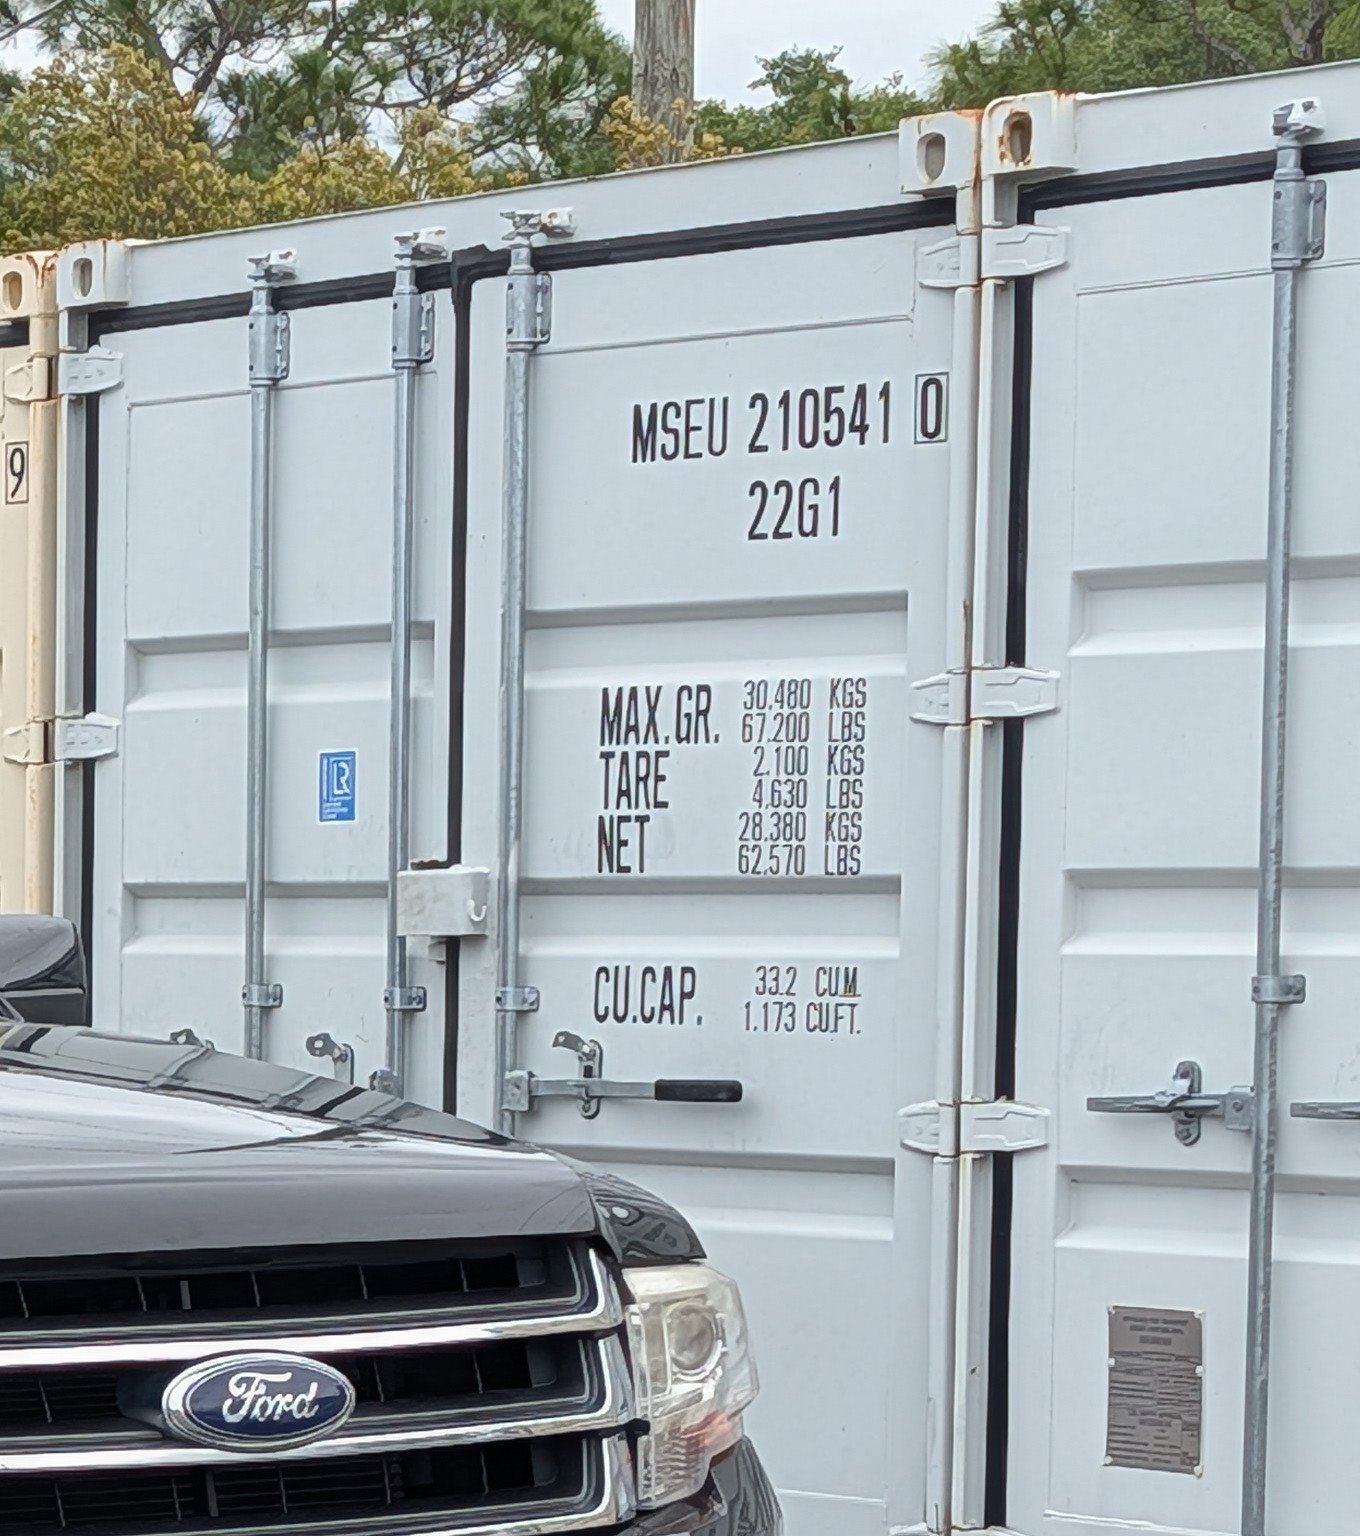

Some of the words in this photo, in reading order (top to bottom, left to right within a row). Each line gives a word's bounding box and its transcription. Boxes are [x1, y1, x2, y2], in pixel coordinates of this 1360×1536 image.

[632, 397, 728, 463] MSEU
[748, 381, 890, 453] 210541
[920, 377, 944, 440] 0
[10, 447, 25, 498] 9
[748, 475, 841, 540] 22G1
[829, 678, 867, 709] KGS
[828, 711, 866, 743] LBS
[599, 750, 670, 809] TARE
[827, 744, 865, 776] KGS
[826, 778, 864, 809] LBS
[597, 814, 651, 874] NET
[825, 811, 863, 842] KGS
[824, 844, 862, 875] LBS
[593, 965, 703, 1025] CU.CAP.
[755, 965, 797, 996] 33.2
[222, 1371, 320, 1423] Ford
